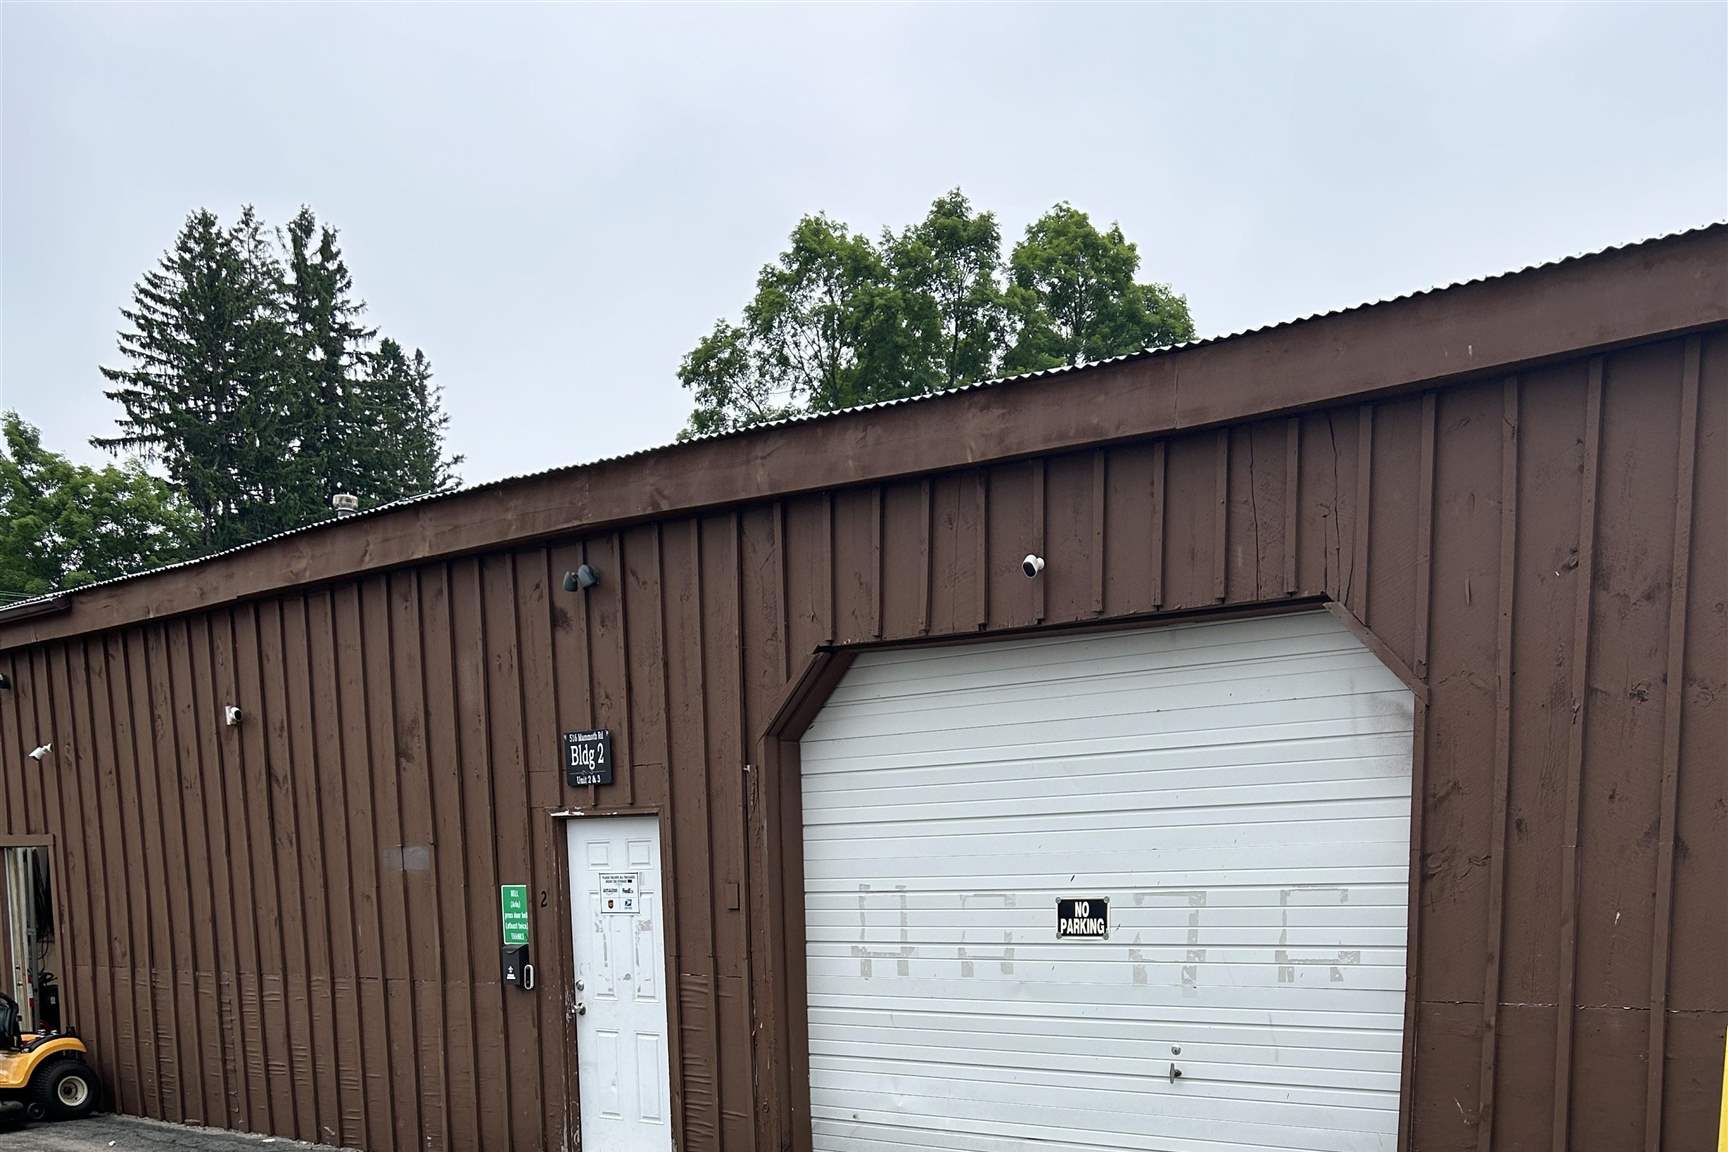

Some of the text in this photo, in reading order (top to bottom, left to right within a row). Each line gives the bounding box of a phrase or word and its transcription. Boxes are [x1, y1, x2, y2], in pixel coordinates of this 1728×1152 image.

[570, 742, 604, 770] Bldg 2
[576, 775, 587, 785] Unit
[587, 774, 592, 784] 2
[541, 890, 548, 908] 2
[1074, 901, 1090, 918] NO
[1060, 918, 1105, 935] PARKING
